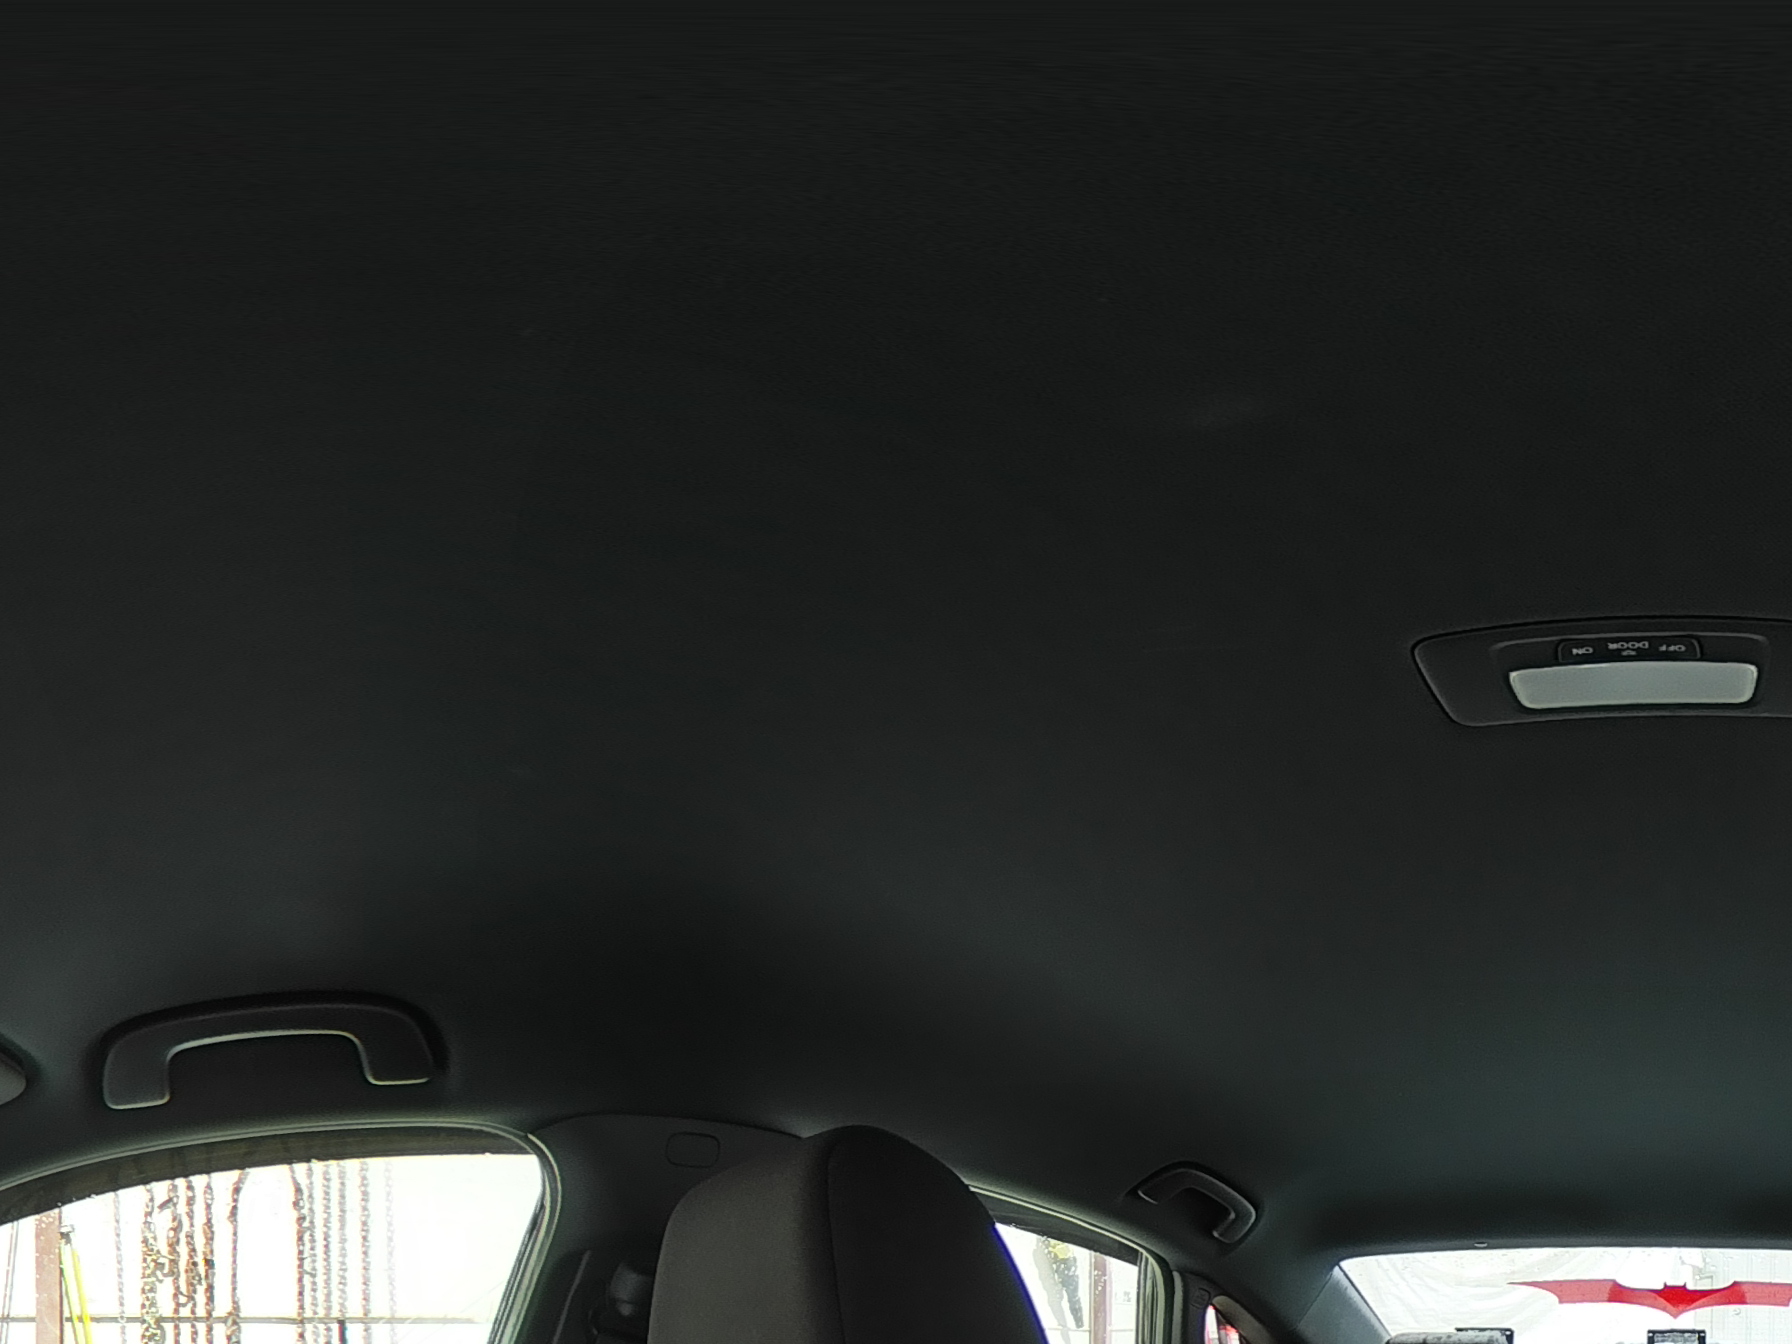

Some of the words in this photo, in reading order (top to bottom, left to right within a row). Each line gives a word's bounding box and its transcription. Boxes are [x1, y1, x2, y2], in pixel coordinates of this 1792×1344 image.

[1607, 641, 1650, 650] DOOR
[1658, 643, 1686, 652] OFF
[1572, 646, 1594, 655] ON
